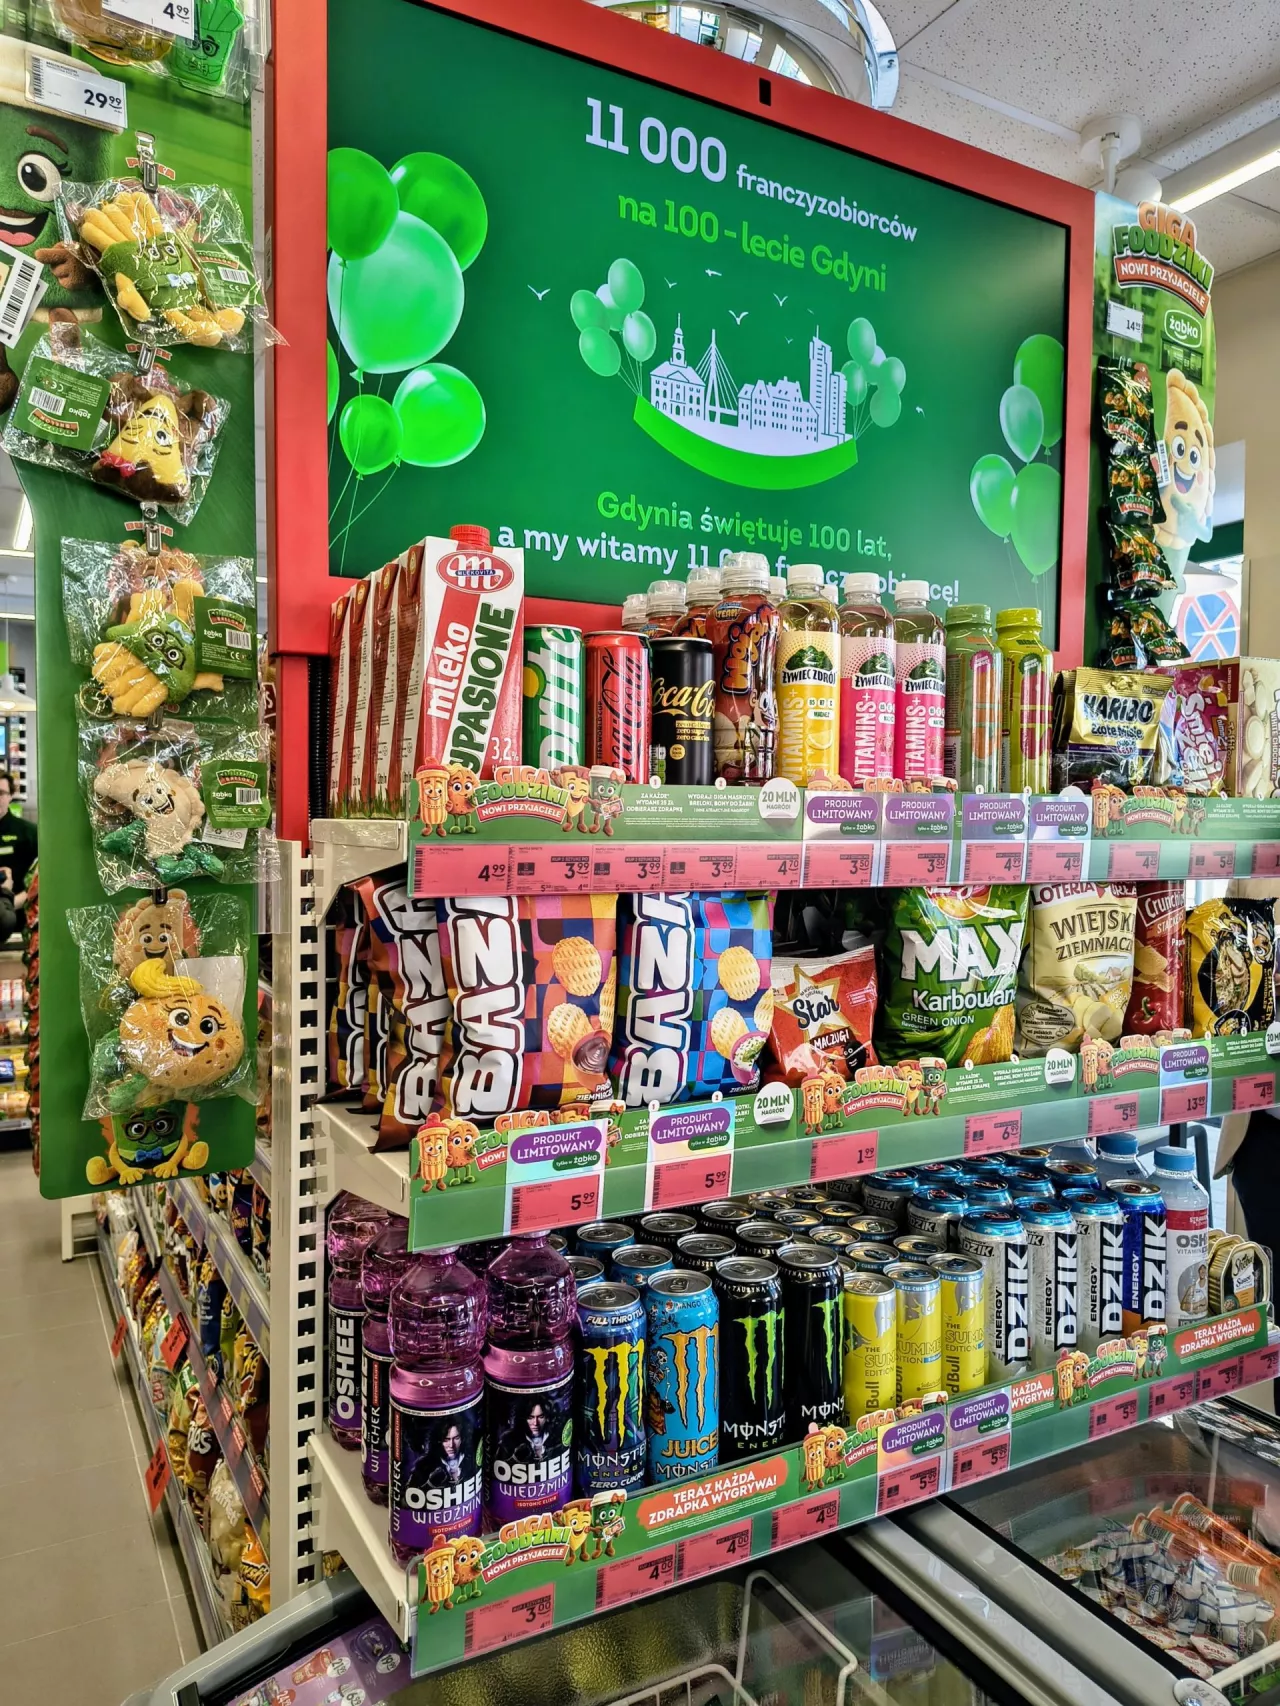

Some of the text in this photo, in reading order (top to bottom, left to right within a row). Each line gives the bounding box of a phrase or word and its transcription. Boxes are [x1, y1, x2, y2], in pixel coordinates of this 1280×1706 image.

[586, 97, 917, 242] 11 000 franczyzobiorców
[1138, 201, 1196, 250] GIGA
[619, 195, 656, 227] na
[811, 245, 887, 293] Gdyni
[1114, 225, 1214, 291] FOODZIKI
[1121, 263, 1206, 307] NOWI PRZYJACIELE
[1168, 315, 1199, 339] żabka
[597, 491, 893, 560] Gdynia świętuje 100 lat,
[498, 526, 516, 547] a
[524, 528, 567, 561] my
[576, 532, 678, 570] witamy
[687, 543, 709, 569] 11
[455, 569, 497, 577] MLEKOVITA
[427, 622, 470, 720] mleko
[782, 668, 812, 684] ŻYWIEC
[855, 672, 882, 690] ŻYWIEC
[905, 679, 932, 694] ŻYWIEC
[1082, 694, 1154, 723] HARIBO
[495, 768, 551, 785] GIGA
[475, 782, 569, 805] FOODZIKI
[762, 791, 797, 803] 20 MLN
[482, 803, 562, 818] NOWI PRZYJACIELE
[812, 809, 873, 820] LIMITOWANY
[824, 800, 862, 809] PRODUKT
[901, 801, 936, 810] PRODUKT
[890, 810, 946, 821] LIMITOWANY
[856, 823, 876, 833] żabka
[930, 824, 948, 834] żabka
[1032, 882, 1095, 906] LOTERIA
[901, 922, 1024, 982] MAX
[913, 989, 1016, 1012] Karbowan
[793, 995, 840, 1029] Star
[902, 1013, 975, 1027] GREEN ONION
[814, 1029, 850, 1050] MACZUGI
[1165, 1057, 1206, 1069] LIMITOWANY
[1173, 1048, 1198, 1059] PRODUKT
[1047, 1058, 1073, 1071] 20 MLN
[757, 1094, 790, 1109] 20 MLN
[841, 1078, 907, 1105] FOODZIKI
[847, 1097, 903, 1112] NOWI PRZYJACIELE
[495, 1111, 550, 1130] GIGA
[671, 1112, 713, 1126] PRODUKT
[533, 1131, 581, 1145] PRODUKT
[657, 1120, 725, 1140] LIMITOWANY
[706, 1134, 727, 1145] żabka
[481, 1151, 507, 1166] NOWI
[517, 1139, 595, 1160] LIMITOWANY
[573, 1153, 598, 1165] żabka
[963, 1239, 994, 1257] DZIK
[1144, 1215, 1166, 1321] DZIK
[1103, 1224, 1124, 1334] DZIK
[1132, 1251, 1141, 1310] ENERGY
[1057, 1236, 1077, 1348] DZIK
[1090, 1266, 1098, 1323] ENERGY
[677, 1301, 701, 1310] MANGO
[1008, 1247, 1029, 1362] DZIK
[1045, 1277, 1053, 1336] ENERGY
[586, 1315, 609, 1326] FULL
[995, 1288, 1003, 1349] ENERGY
[1180, 1323, 1255, 1353] ZDRAPKA WYGRYWA!
[1194, 1318, 1241, 1341] TERAZ KAŻDA
[946, 1343, 978, 1352] EDITION
[336, 1318, 354, 1420] OSHEE
[1012, 1380, 1042, 1397] KAŻDA
[954, 1405, 1005, 1428] LIMITOWANY
[964, 1399, 996, 1415] PRODUKT
[857, 1410, 896, 1431] GIGA
[897, 1418, 931, 1435] PRODUKT
[371, 1407, 381, 1473] WITCHER
[886, 1425, 941, 1449] LIMITOWANY
[494, 1450, 570, 1484] OSHEE
[593, 1460, 642, 1478] ENERGY
[405, 1469, 482, 1510] OSHEE
[500, 1473, 568, 1499] WIEDŹMIN
[590, 1478, 618, 1488] ZERO
[674, 1471, 755, 1505] TERAZ KAŻDA
[411, 1493, 481, 1525] WIEDŹMIN
[516, 1495, 557, 1507] ISOTONIC ELIXIR
[649, 1499, 709, 1526] ZDRAPKA
[711, 1475, 777, 1506] WYGRYWA!
[432, 1518, 472, 1534] ISOTONIC ELIXIR
[500, 1513, 552, 1543] GIGA
[480, 1527, 571, 1569] FOODZIKI
[487, 1547, 565, 1578] NOWI PRZYJACIELE
